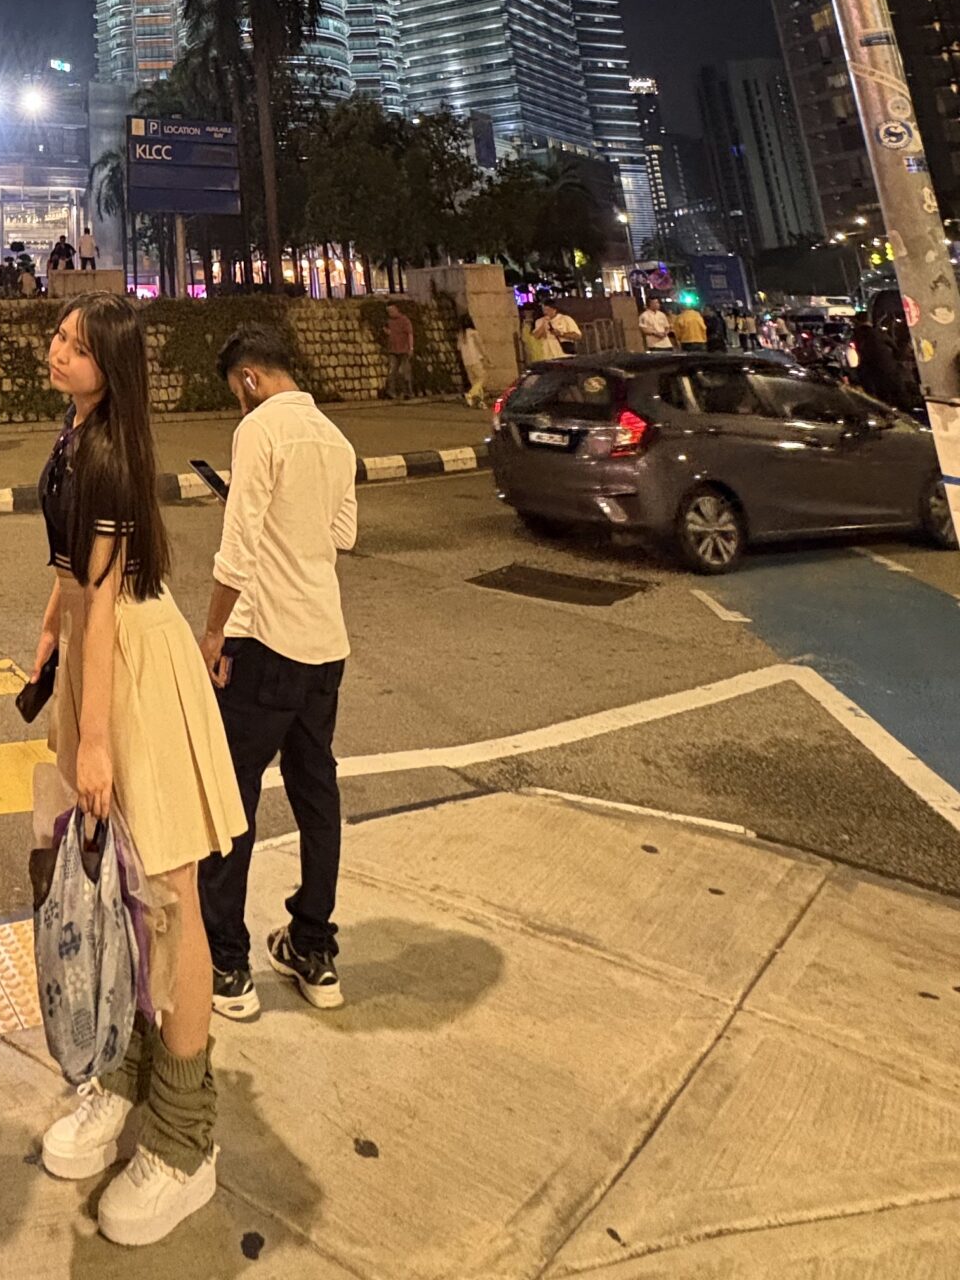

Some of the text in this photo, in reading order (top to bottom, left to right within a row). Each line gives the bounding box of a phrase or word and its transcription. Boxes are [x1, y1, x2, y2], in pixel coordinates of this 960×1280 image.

[150, 122, 200, 135] P LOCATION
[136, 144, 172, 160] KLCC
